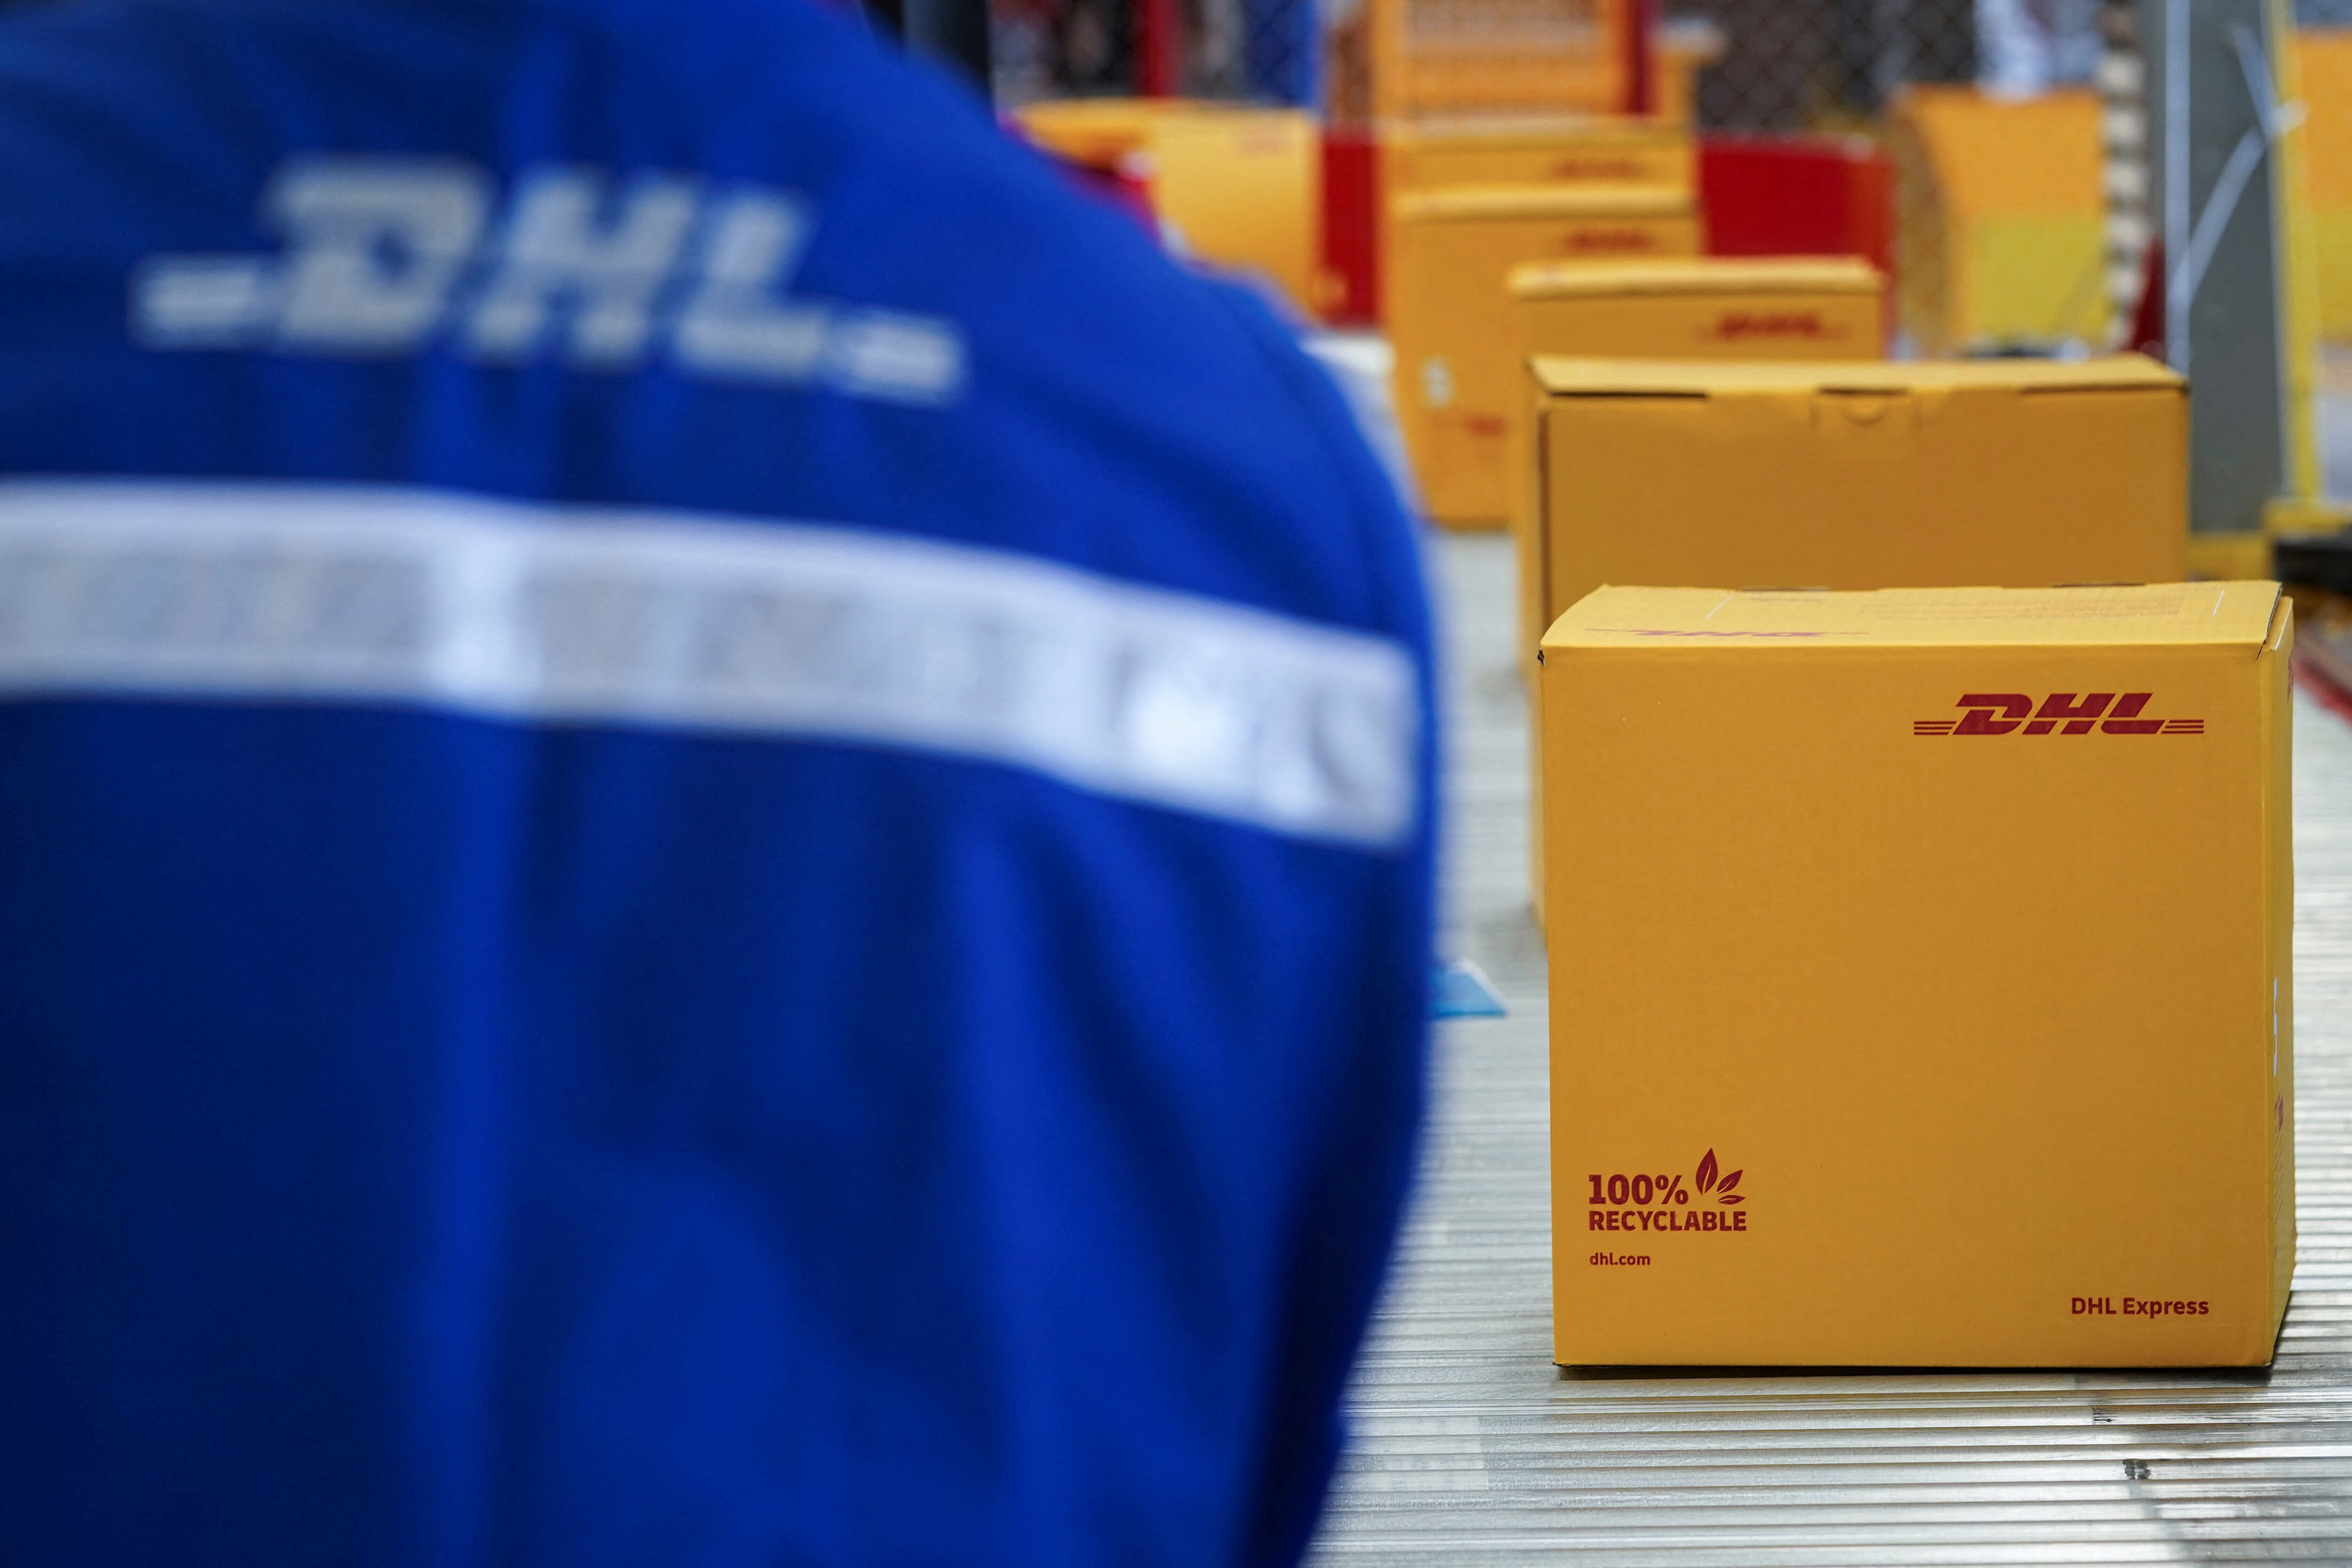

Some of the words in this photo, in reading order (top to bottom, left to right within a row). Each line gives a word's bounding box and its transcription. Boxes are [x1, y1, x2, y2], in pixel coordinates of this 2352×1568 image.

[259, 153, 830, 387] DHL
[1951, 692, 2166, 735] DHL
[1589, 1174, 1689, 1205] 100%
[1589, 1210, 1747, 1232] RECYCLABLE
[1589, 1252, 1651, 1266] dhl.com
[2071, 1297, 2117, 1314] DHL
[2123, 1297, 2209, 1319] Express
